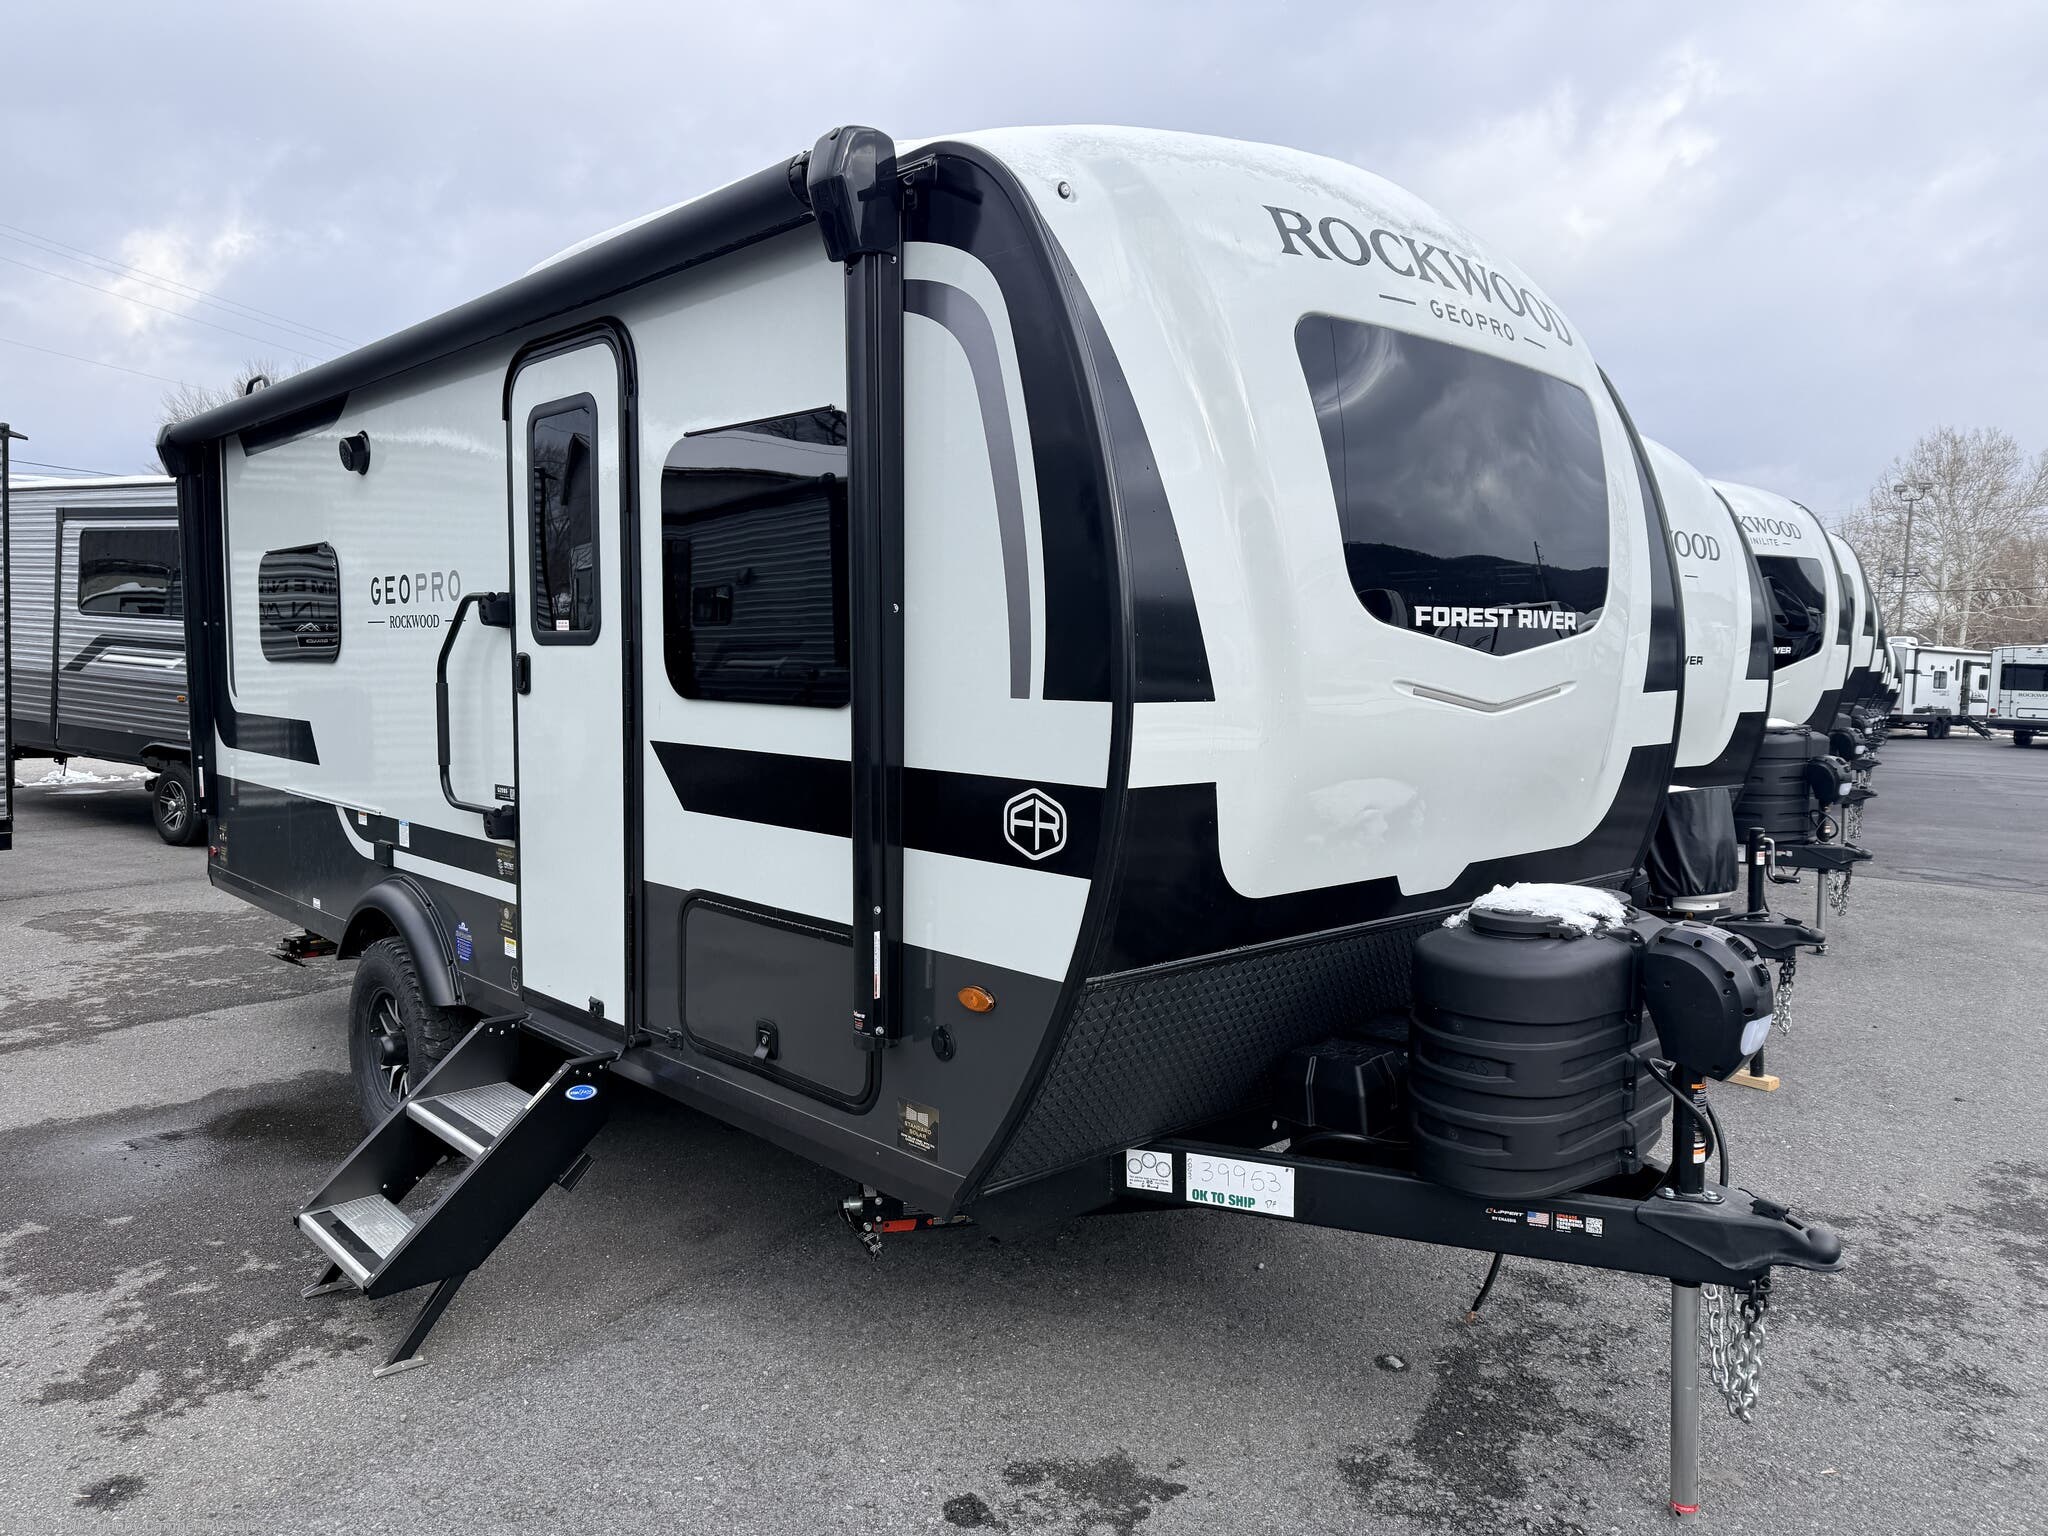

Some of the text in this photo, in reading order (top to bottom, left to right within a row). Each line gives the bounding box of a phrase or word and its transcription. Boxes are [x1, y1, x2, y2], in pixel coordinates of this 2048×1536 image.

[1262, 205, 1573, 346] ROCKWOOD
[1430, 299, 1516, 342] GEOPRO
[1670, 530, 1721, 561] OOD
[371, 569, 461, 606] GEOPRO
[389, 614, 440, 629] ROCKWOOD
[1414, 605, 1577, 631] FOREST RIVER
[1201, 1161, 1282, 1193] 39953
[1191, 1188, 1256, 1208] OK TO SHIP
